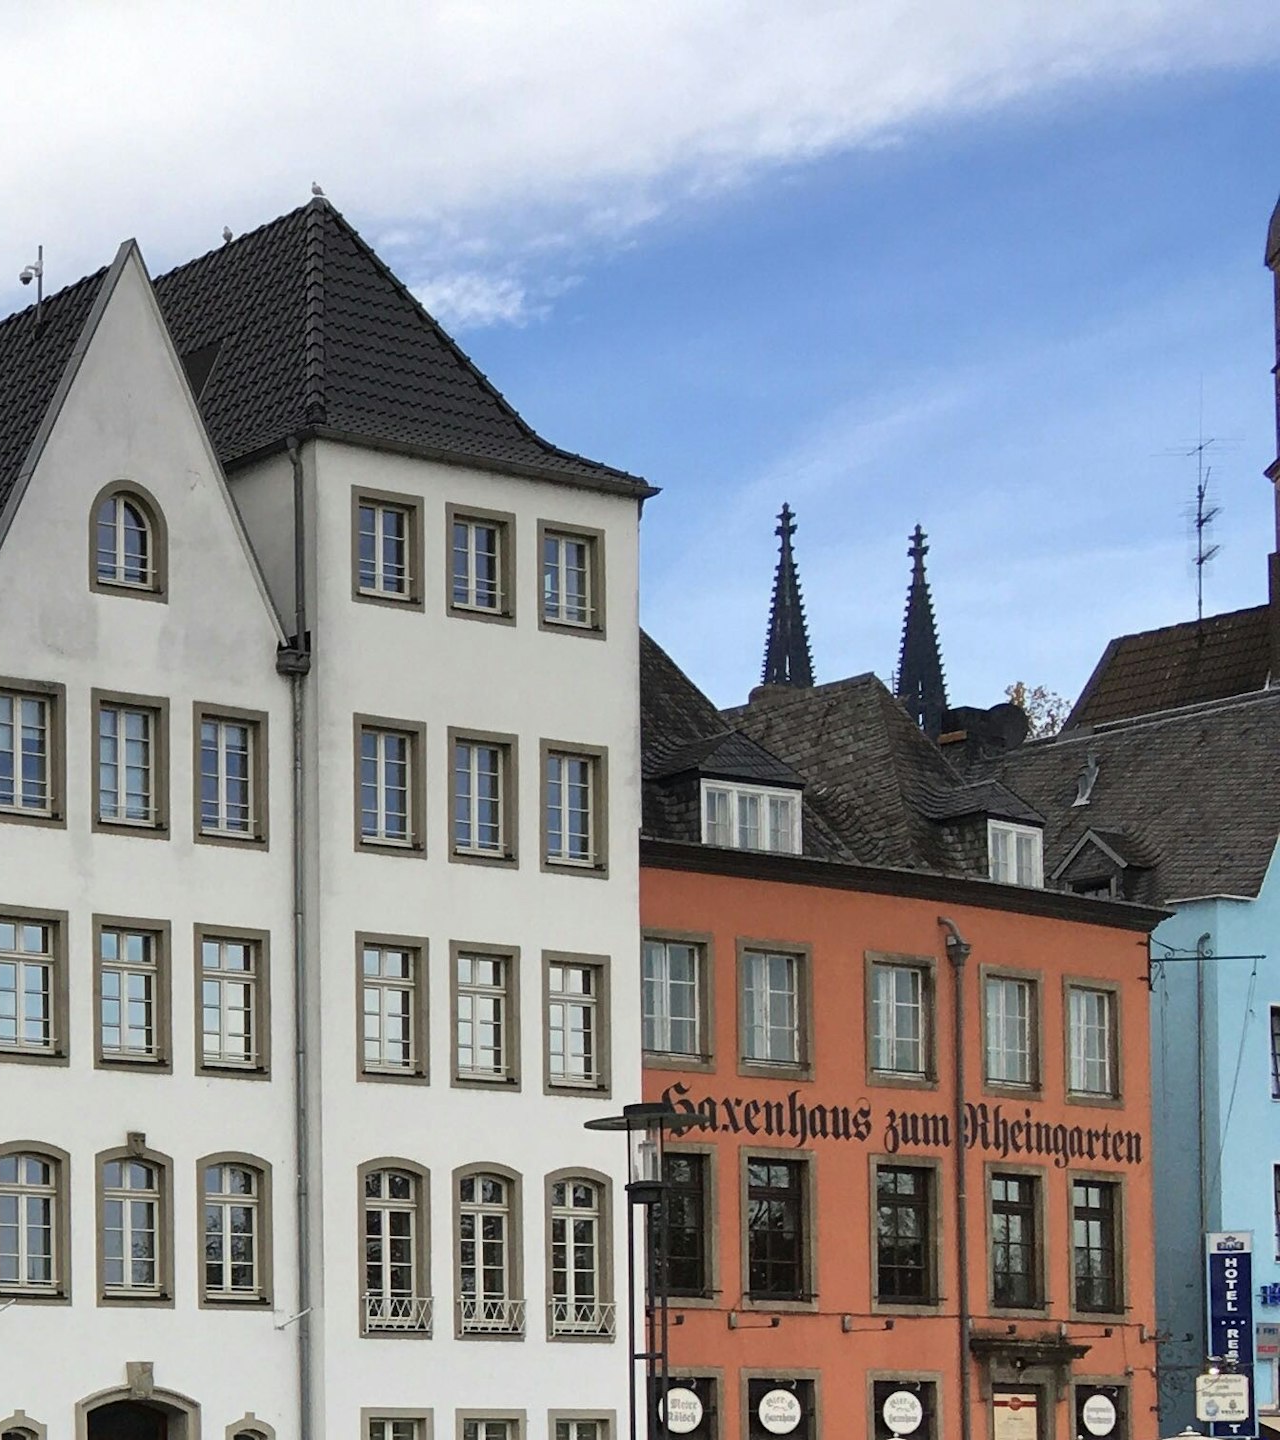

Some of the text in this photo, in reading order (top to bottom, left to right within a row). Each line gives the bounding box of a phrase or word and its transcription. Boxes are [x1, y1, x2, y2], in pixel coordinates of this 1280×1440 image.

[884, 1108, 952, 1154] zum
[963, 1102, 1143, 1169] Rheingarten
[1224, 1257, 1239, 1312] HOTEL
